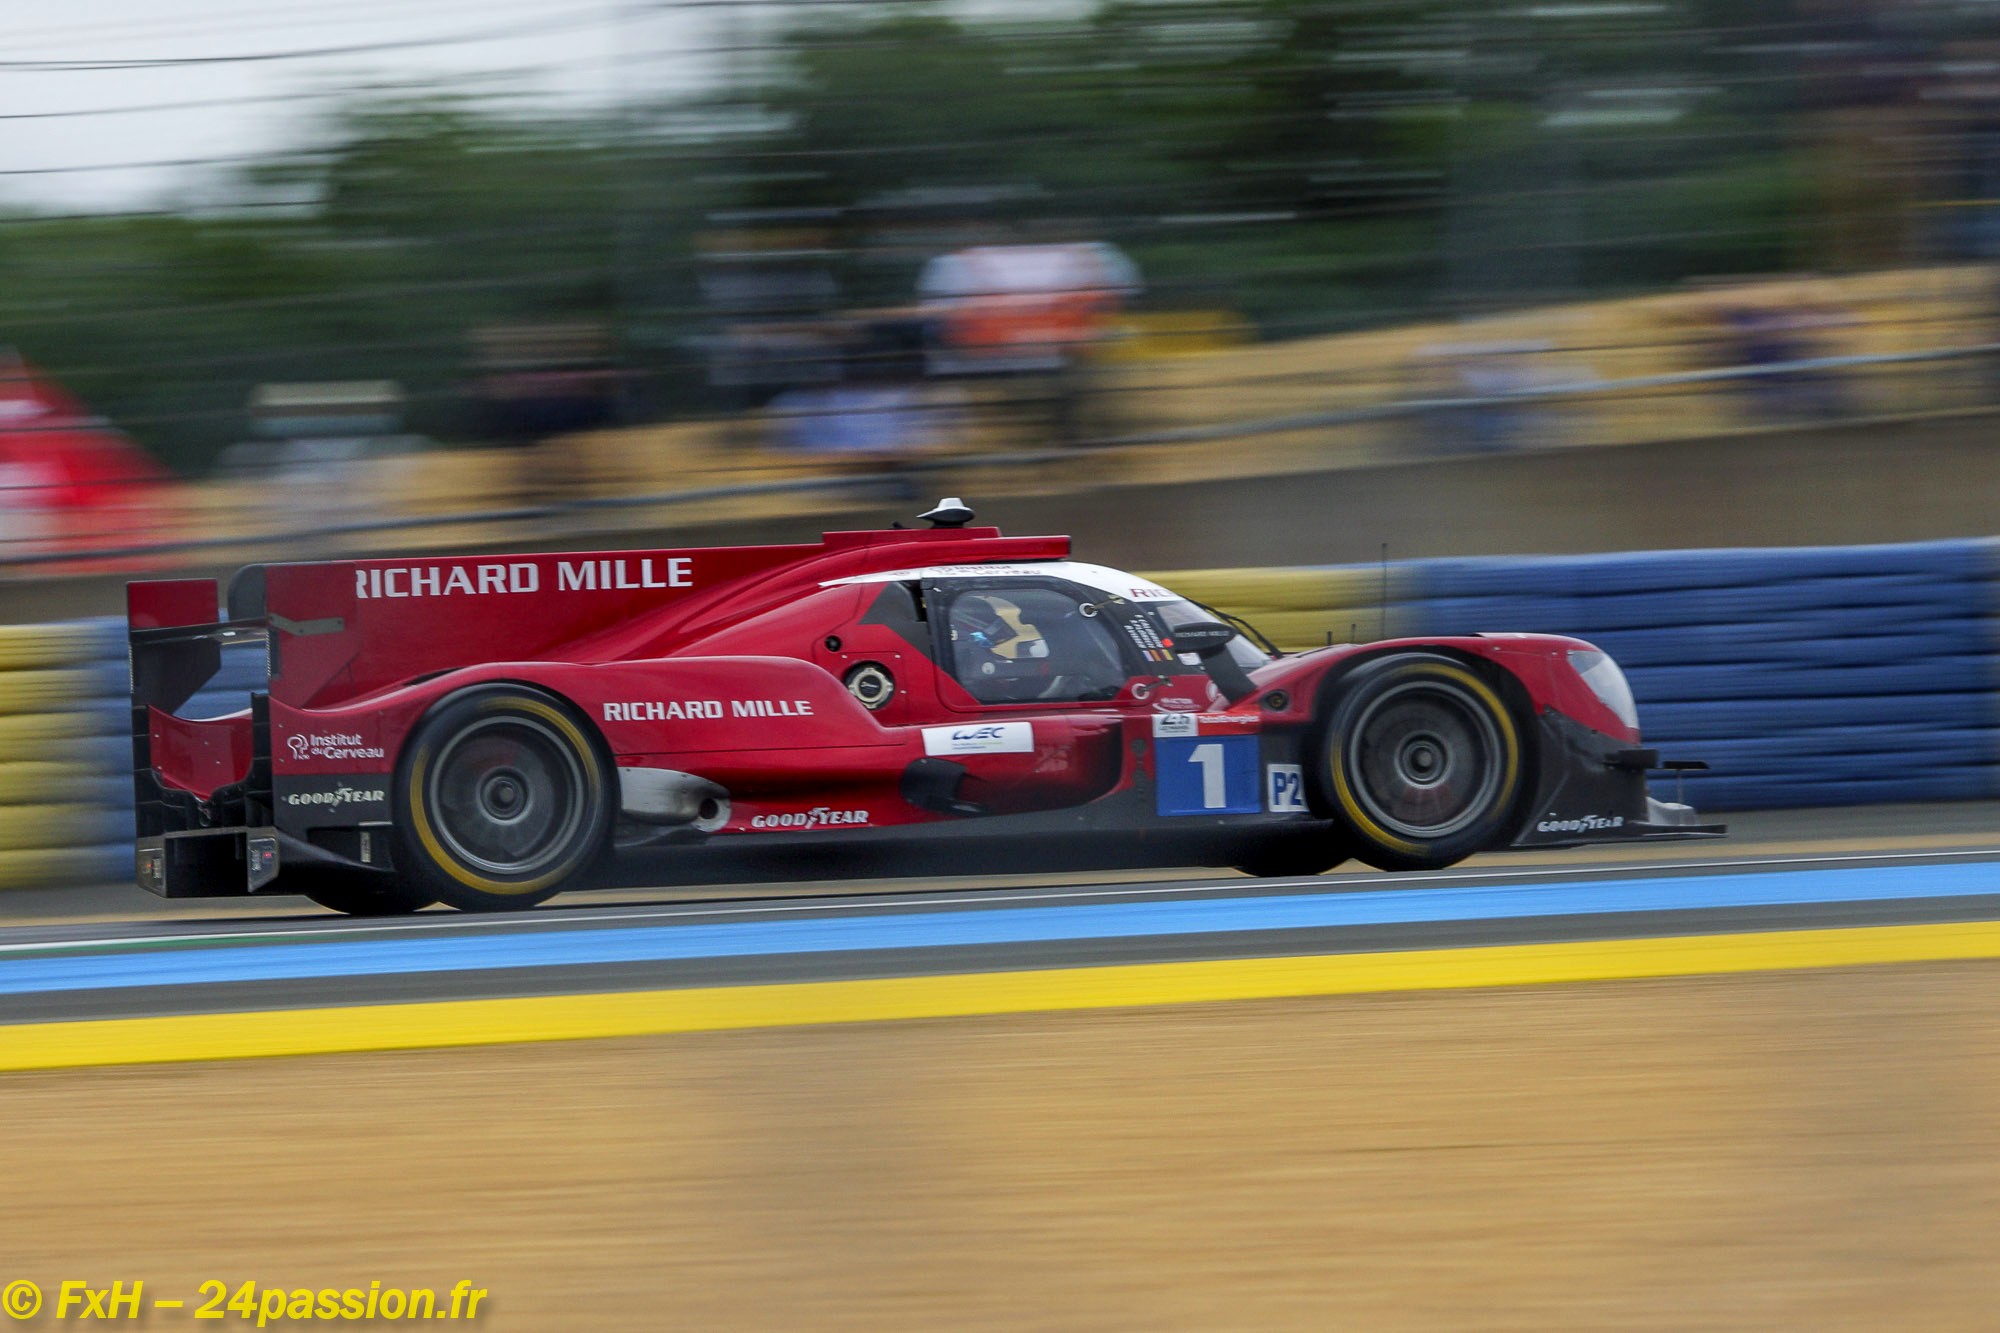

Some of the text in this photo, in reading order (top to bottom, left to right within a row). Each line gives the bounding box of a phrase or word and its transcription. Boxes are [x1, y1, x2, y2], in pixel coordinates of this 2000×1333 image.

[557, 557, 694, 592] MILLE
[603, 699, 815, 722] RICHARD MILLE
[310, 733, 363, 747] Institut
[952, 726, 1006, 741] WEC
[324, 746, 385, 760] Cerveau
[1187, 743, 1227, 809] 1
[287, 787, 385, 808] GOODYEAR
[1271, 771, 1304, 806] P2
[751, 807, 870, 830] GOODYEAR
